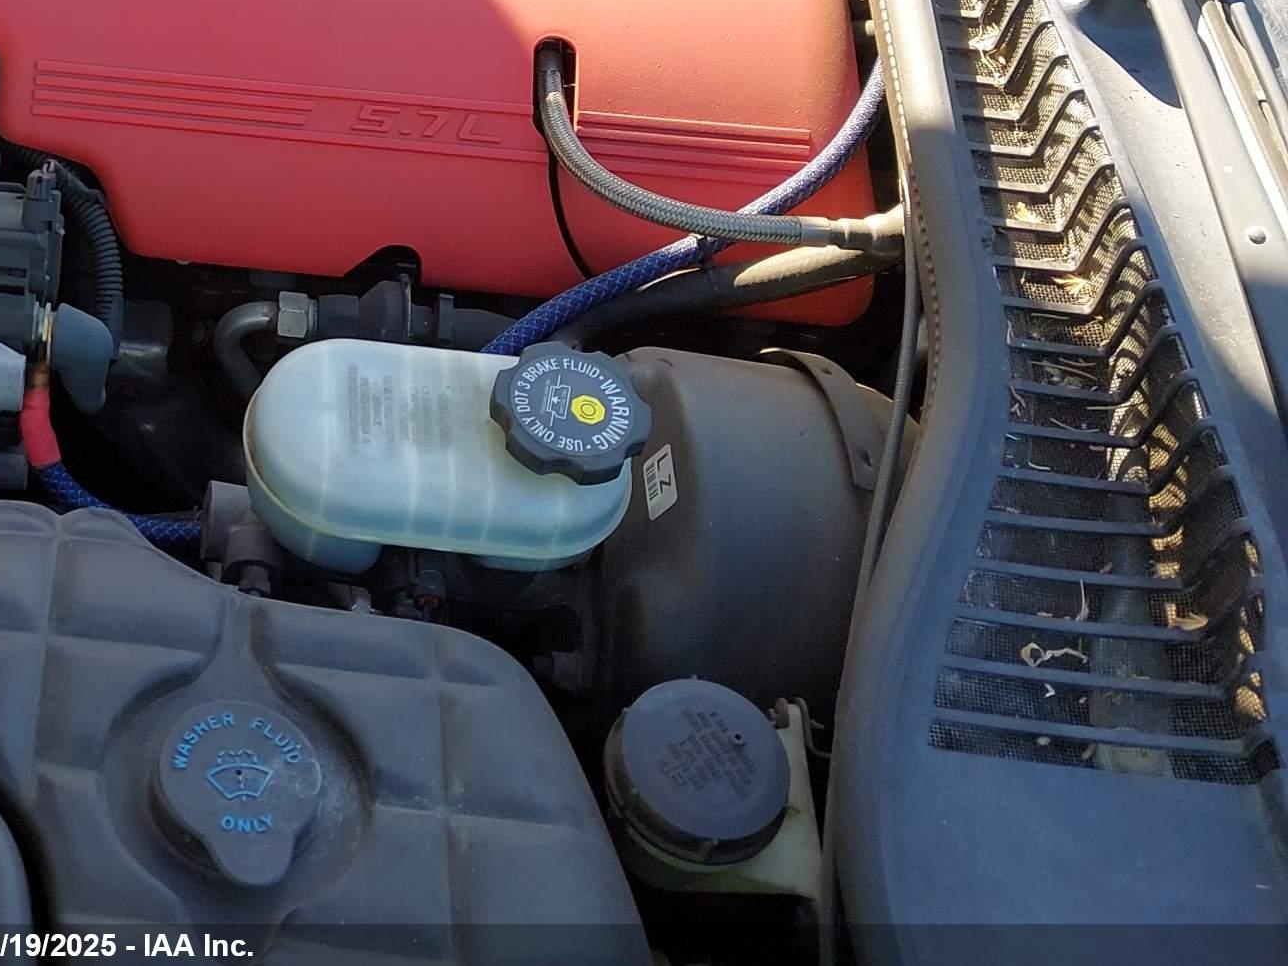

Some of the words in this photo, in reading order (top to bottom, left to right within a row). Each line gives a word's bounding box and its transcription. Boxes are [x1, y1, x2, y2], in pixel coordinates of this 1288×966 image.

[351, 104, 502, 144] 5.7L
[522, 358, 560, 382] BRAKE
[562, 358, 601, 379] FLUID
[517, 381, 530, 390] 3
[514, 390, 531, 414] DOT
[592, 378, 630, 450] WARNING
[521, 416, 555, 443] ONLY
[557, 436, 584, 452] USE
[172, 713, 235, 769] WASHER
[250, 717, 302, 764] FLUID
[221, 814, 273, 832] ONLY
